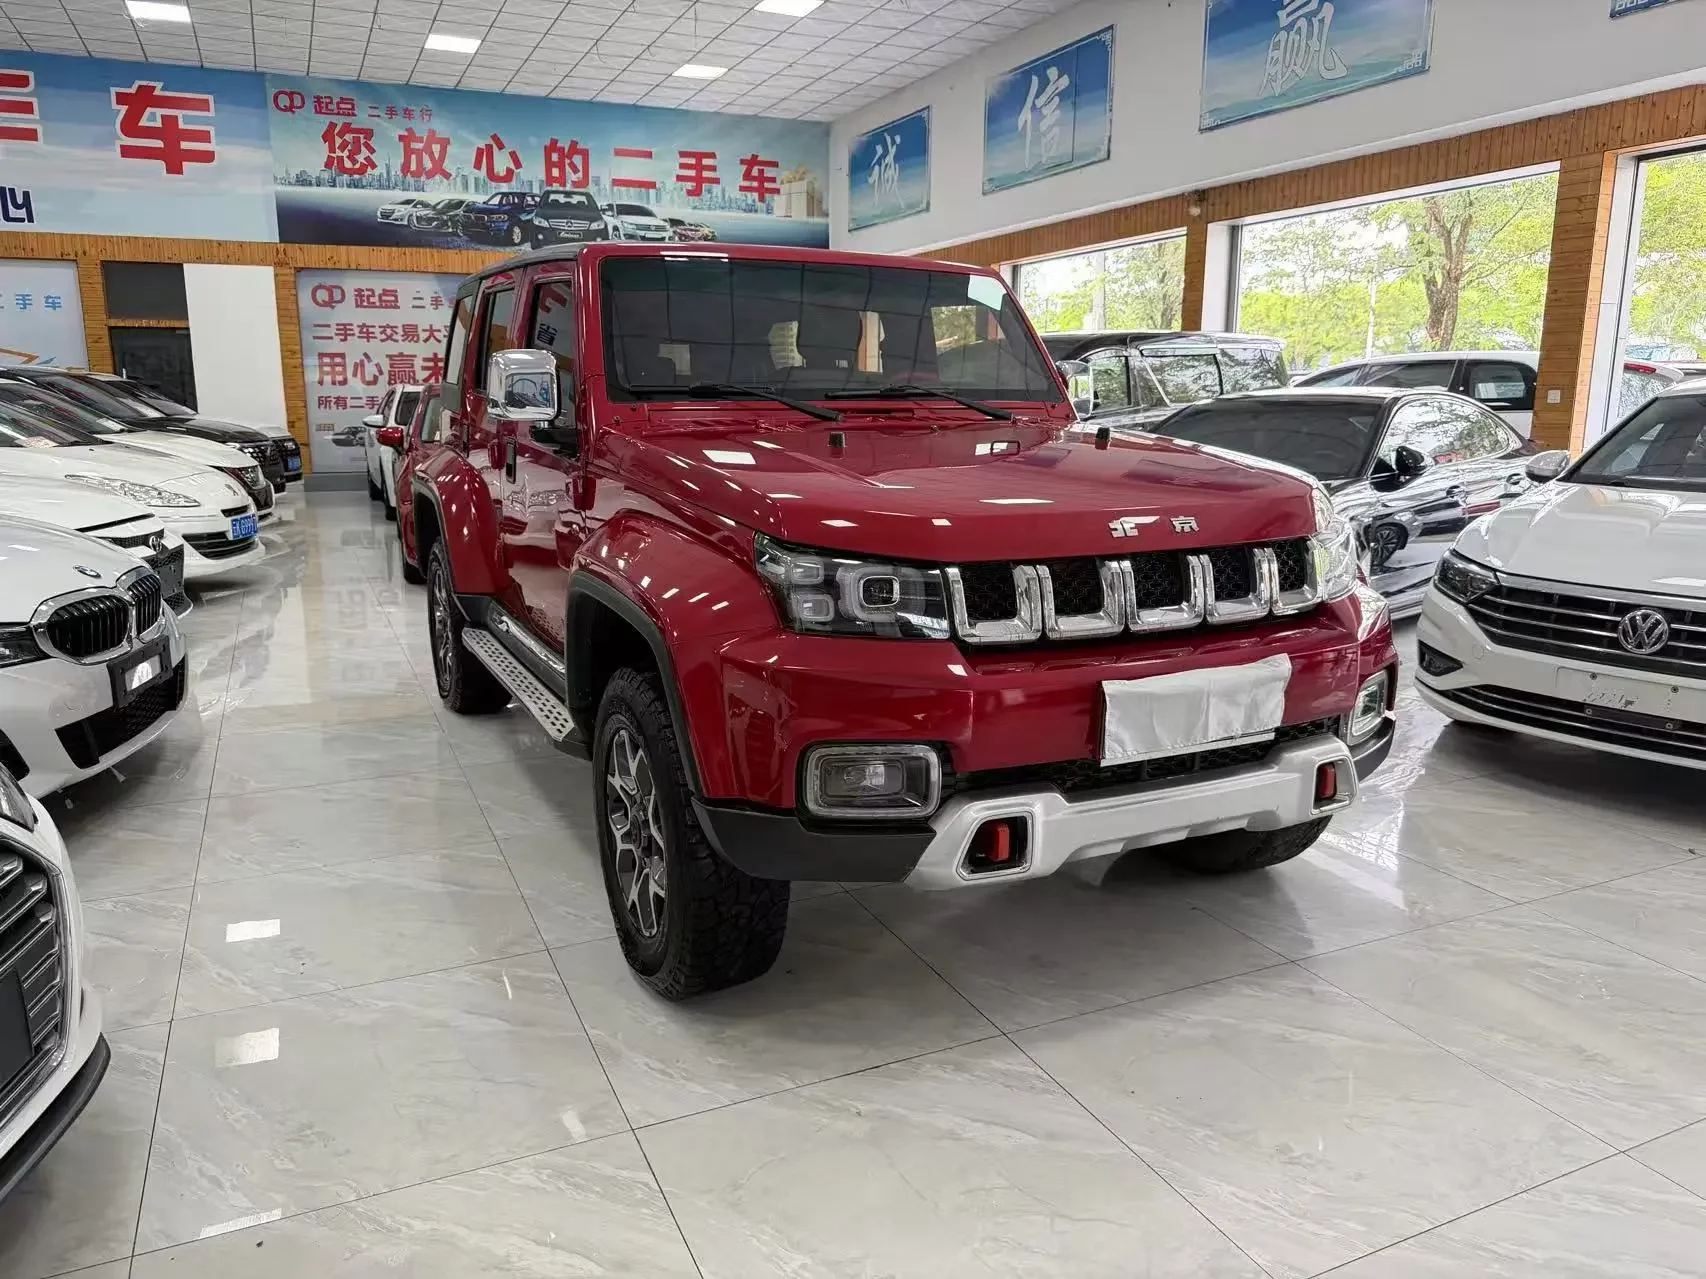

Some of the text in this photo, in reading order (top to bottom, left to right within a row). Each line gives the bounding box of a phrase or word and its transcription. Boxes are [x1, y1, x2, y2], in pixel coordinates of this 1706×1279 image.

[313, 95, 358, 117] 起点
[367, 104, 433, 122] 二手车行
[1017, 66, 1070, 170] 信
[321, 121, 781, 203] 您放心的二手车
[0, 292, 62, 311] 手车
[353, 288, 400, 309] 起点
[317, 395, 384, 410] 所有二手
[1108, 515, 1200, 537] 北京
